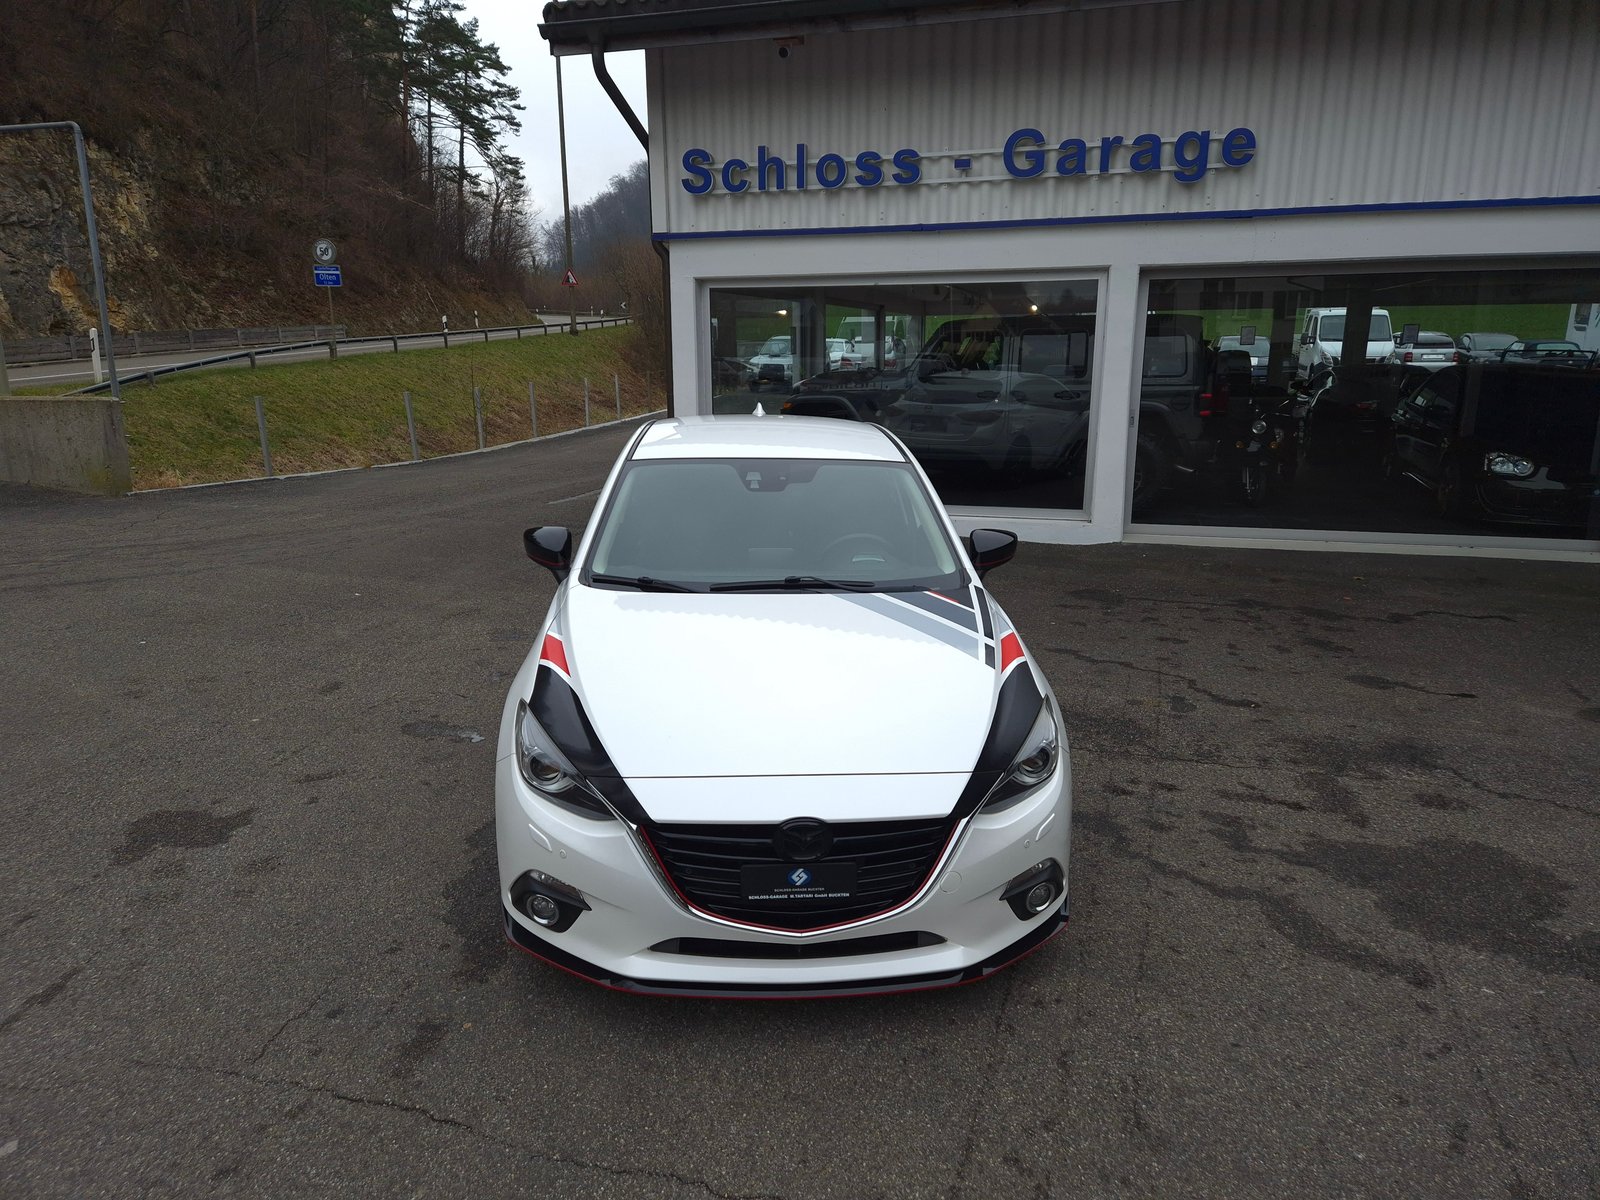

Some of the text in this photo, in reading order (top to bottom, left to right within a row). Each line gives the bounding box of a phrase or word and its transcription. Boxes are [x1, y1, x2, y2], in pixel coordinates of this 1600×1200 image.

[681, 127, 1257, 195] Schloss - Garage
[320, 248, 328, 256] 50
